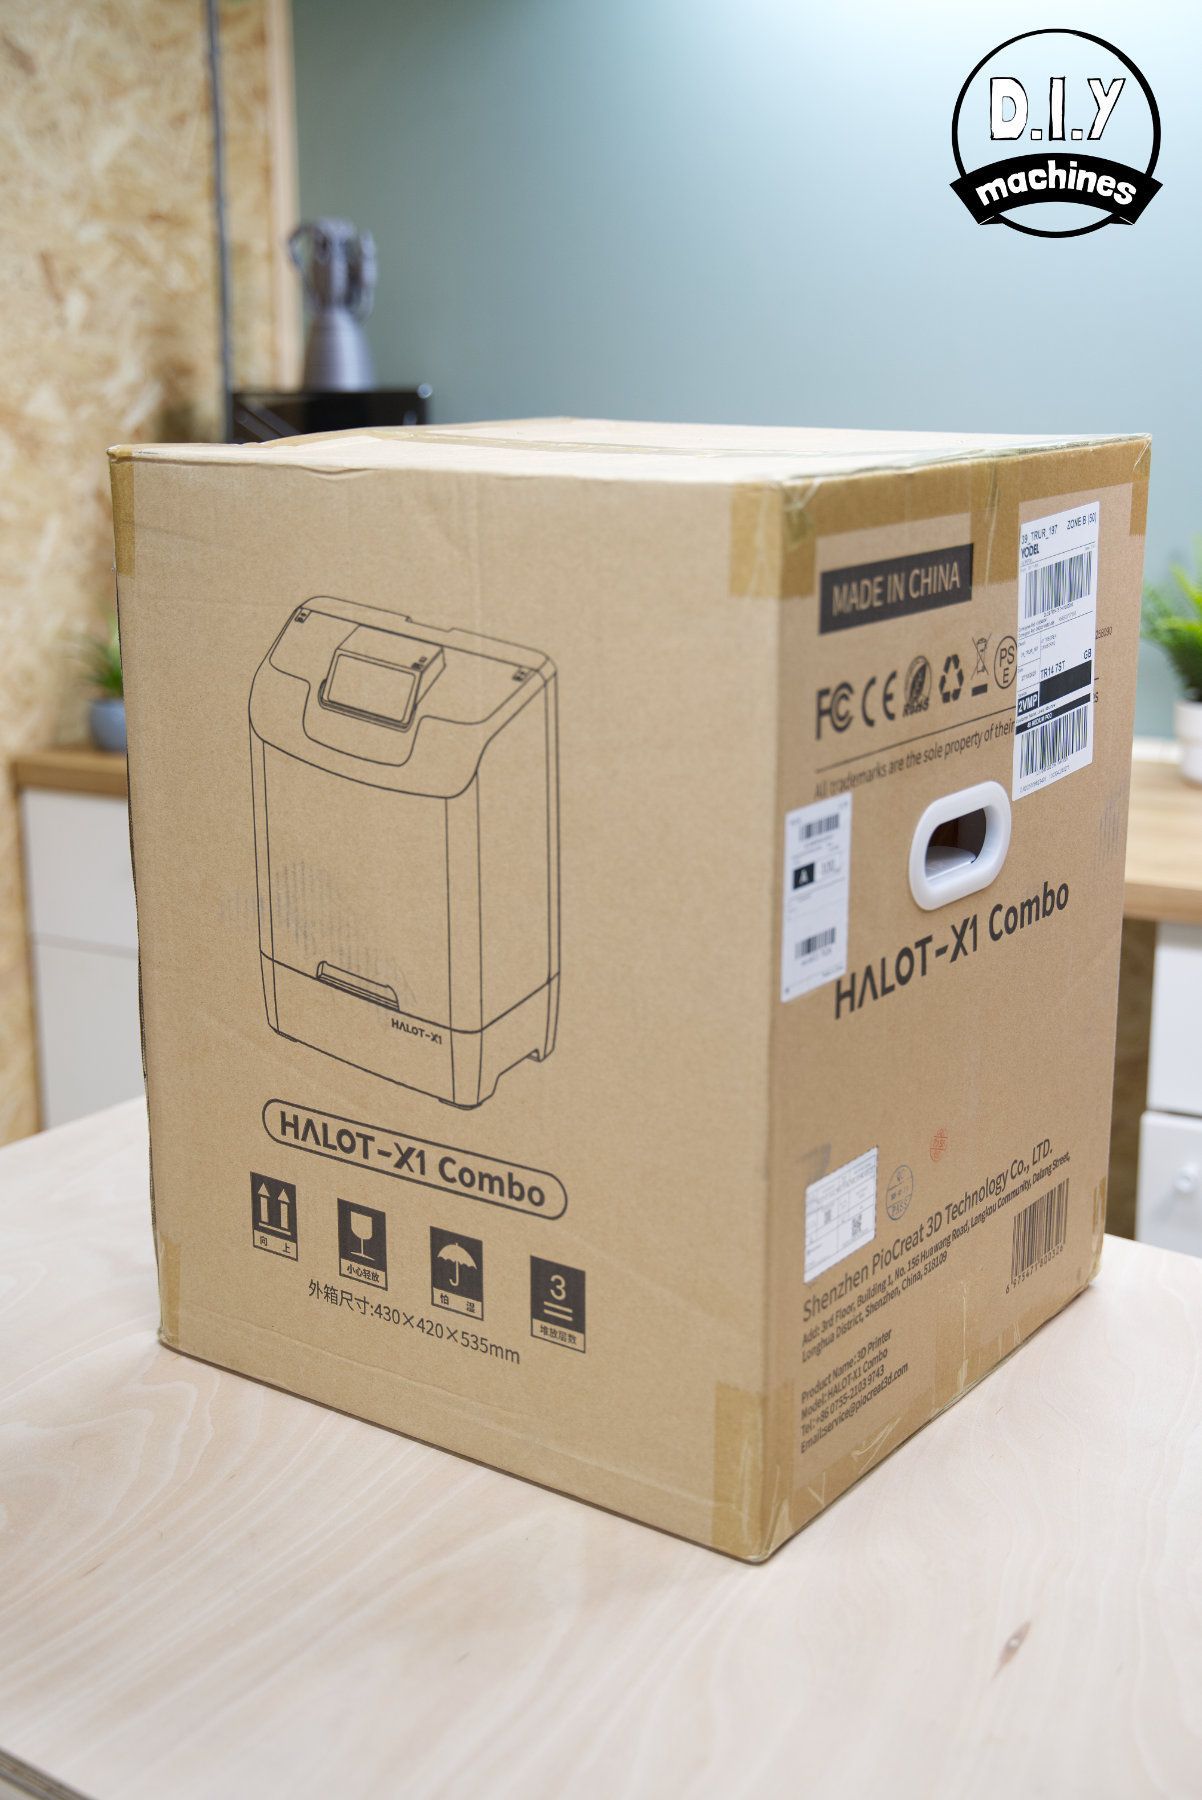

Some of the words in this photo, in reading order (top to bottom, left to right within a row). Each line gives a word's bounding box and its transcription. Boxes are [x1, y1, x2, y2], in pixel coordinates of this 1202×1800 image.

[1021, 544, 1040, 559] YODEL
[831, 574, 883, 616] MADE
[886, 569, 904, 604] IN
[908, 561, 960, 599] CHINA
[1083, 648, 1092, 659] GB
[1040, 665, 1054, 679] TR14
[1018, 693, 1038, 713] 2VMP
[828, 763, 887, 796] trademarks
[888, 757, 904, 778] are
[905, 751, 922, 769] the
[923, 743, 943, 763] sole
[944, 730, 982, 759] property
[984, 725, 995, 743] of
[835, 914, 978, 1020] HALOT-X1
[988, 880, 1070, 942] Combo
[391, 1018, 442, 1045] HALOT-X1
[280, 1110, 426, 1176] HALOT-X1
[438, 1156, 546, 1208] Combo
[803, 1265, 868, 1321] Shenzhen
[872, 1223, 925, 1276] PioCreat
[926, 1211, 942, 1238] 3D
[945, 1169, 1009, 1225] Technology
[1010, 1159, 1030, 1180] Co.,
[1032, 1138, 1053, 1166] LTD.
[550, 1274, 566, 1300] 3
[857, 1278, 887, 1307] Building
[901, 1270, 922, 1291] China,
[801, 1373, 831, 1404] Product
[867, 1328, 892, 1354] Printer
[863, 1347, 888, 1373] Combo
[868, 1364, 885, 1385] 9743
